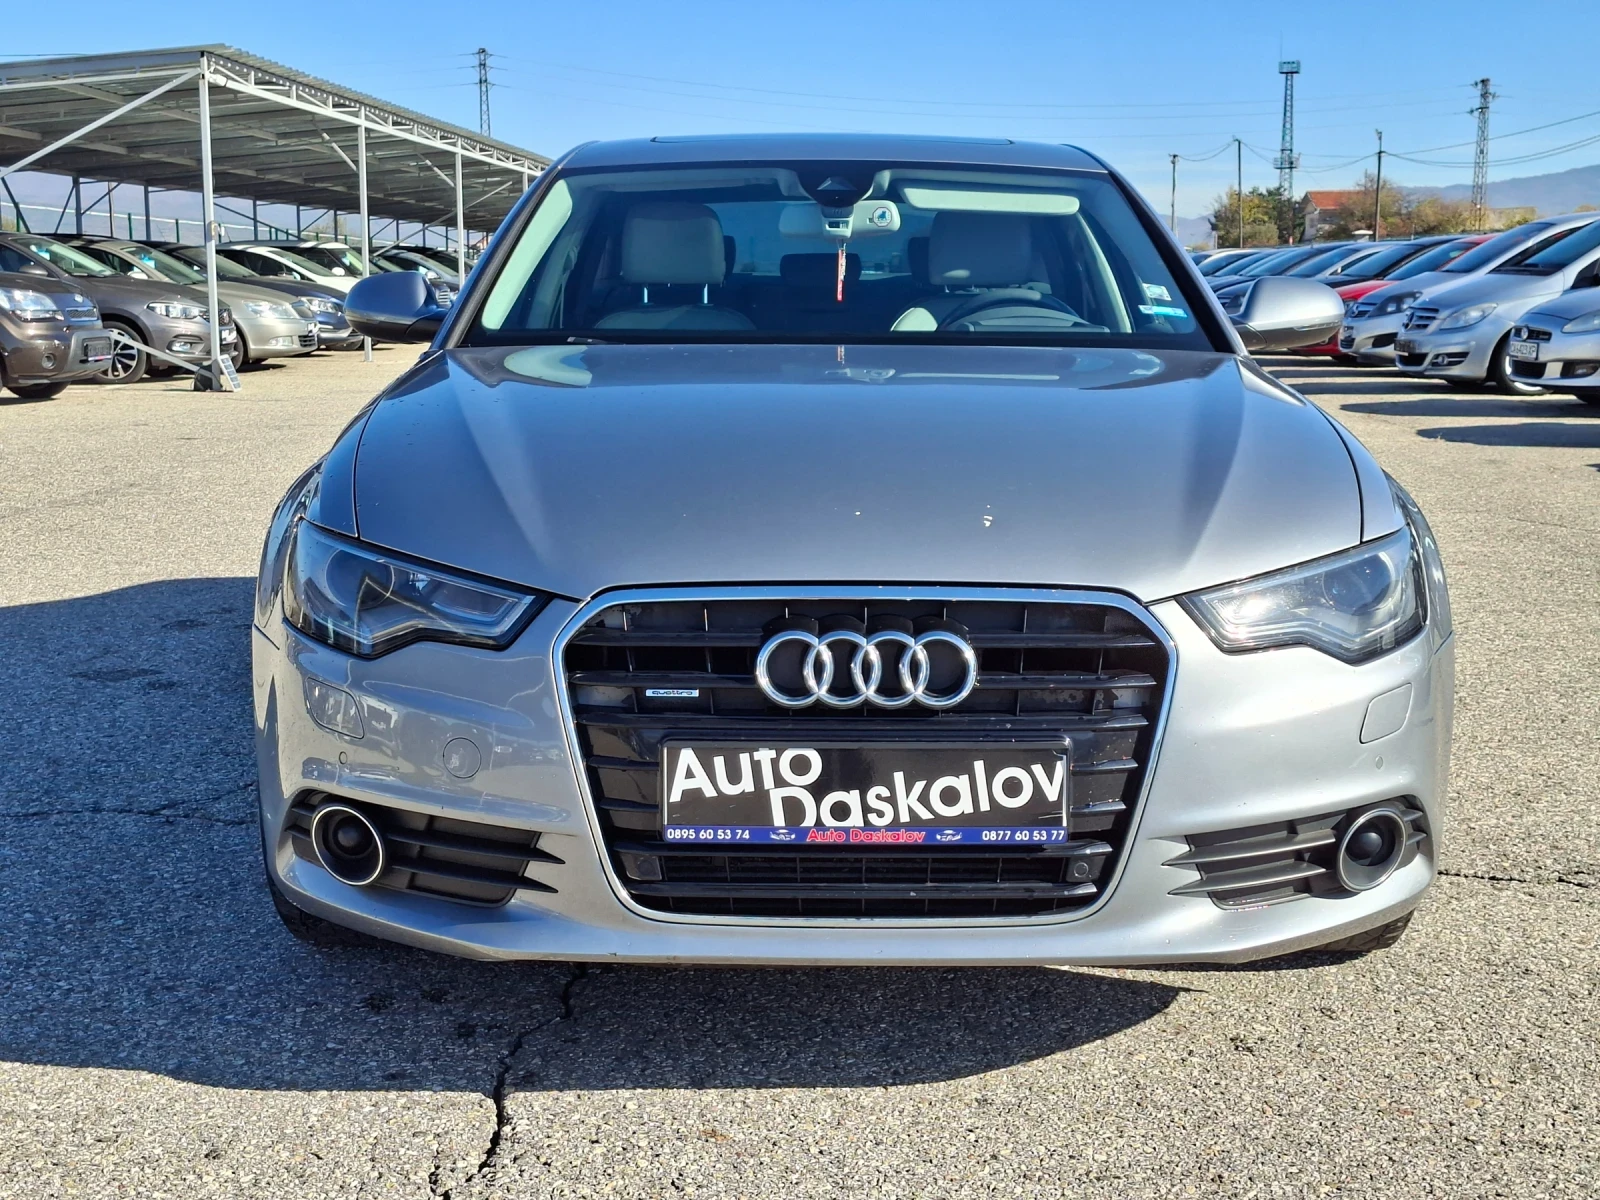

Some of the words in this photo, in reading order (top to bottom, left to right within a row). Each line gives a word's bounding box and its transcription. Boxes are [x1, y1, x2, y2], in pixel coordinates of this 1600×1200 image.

[669, 747, 823, 803] Auto
[769, 759, 1065, 827] Daskalov
[667, 829, 696, 840] 0895
[699, 829, 714, 840] 60
[717, 829, 732, 840] 53
[735, 829, 750, 840] 74
[806, 828, 846, 842] Auto
[850, 828, 926, 842] Daskalov
[981, 830, 1011, 841] 0877
[1014, 830, 1030, 841] 60
[1032, 830, 1048, 841] 53
[1051, 830, 1065, 841] 77
